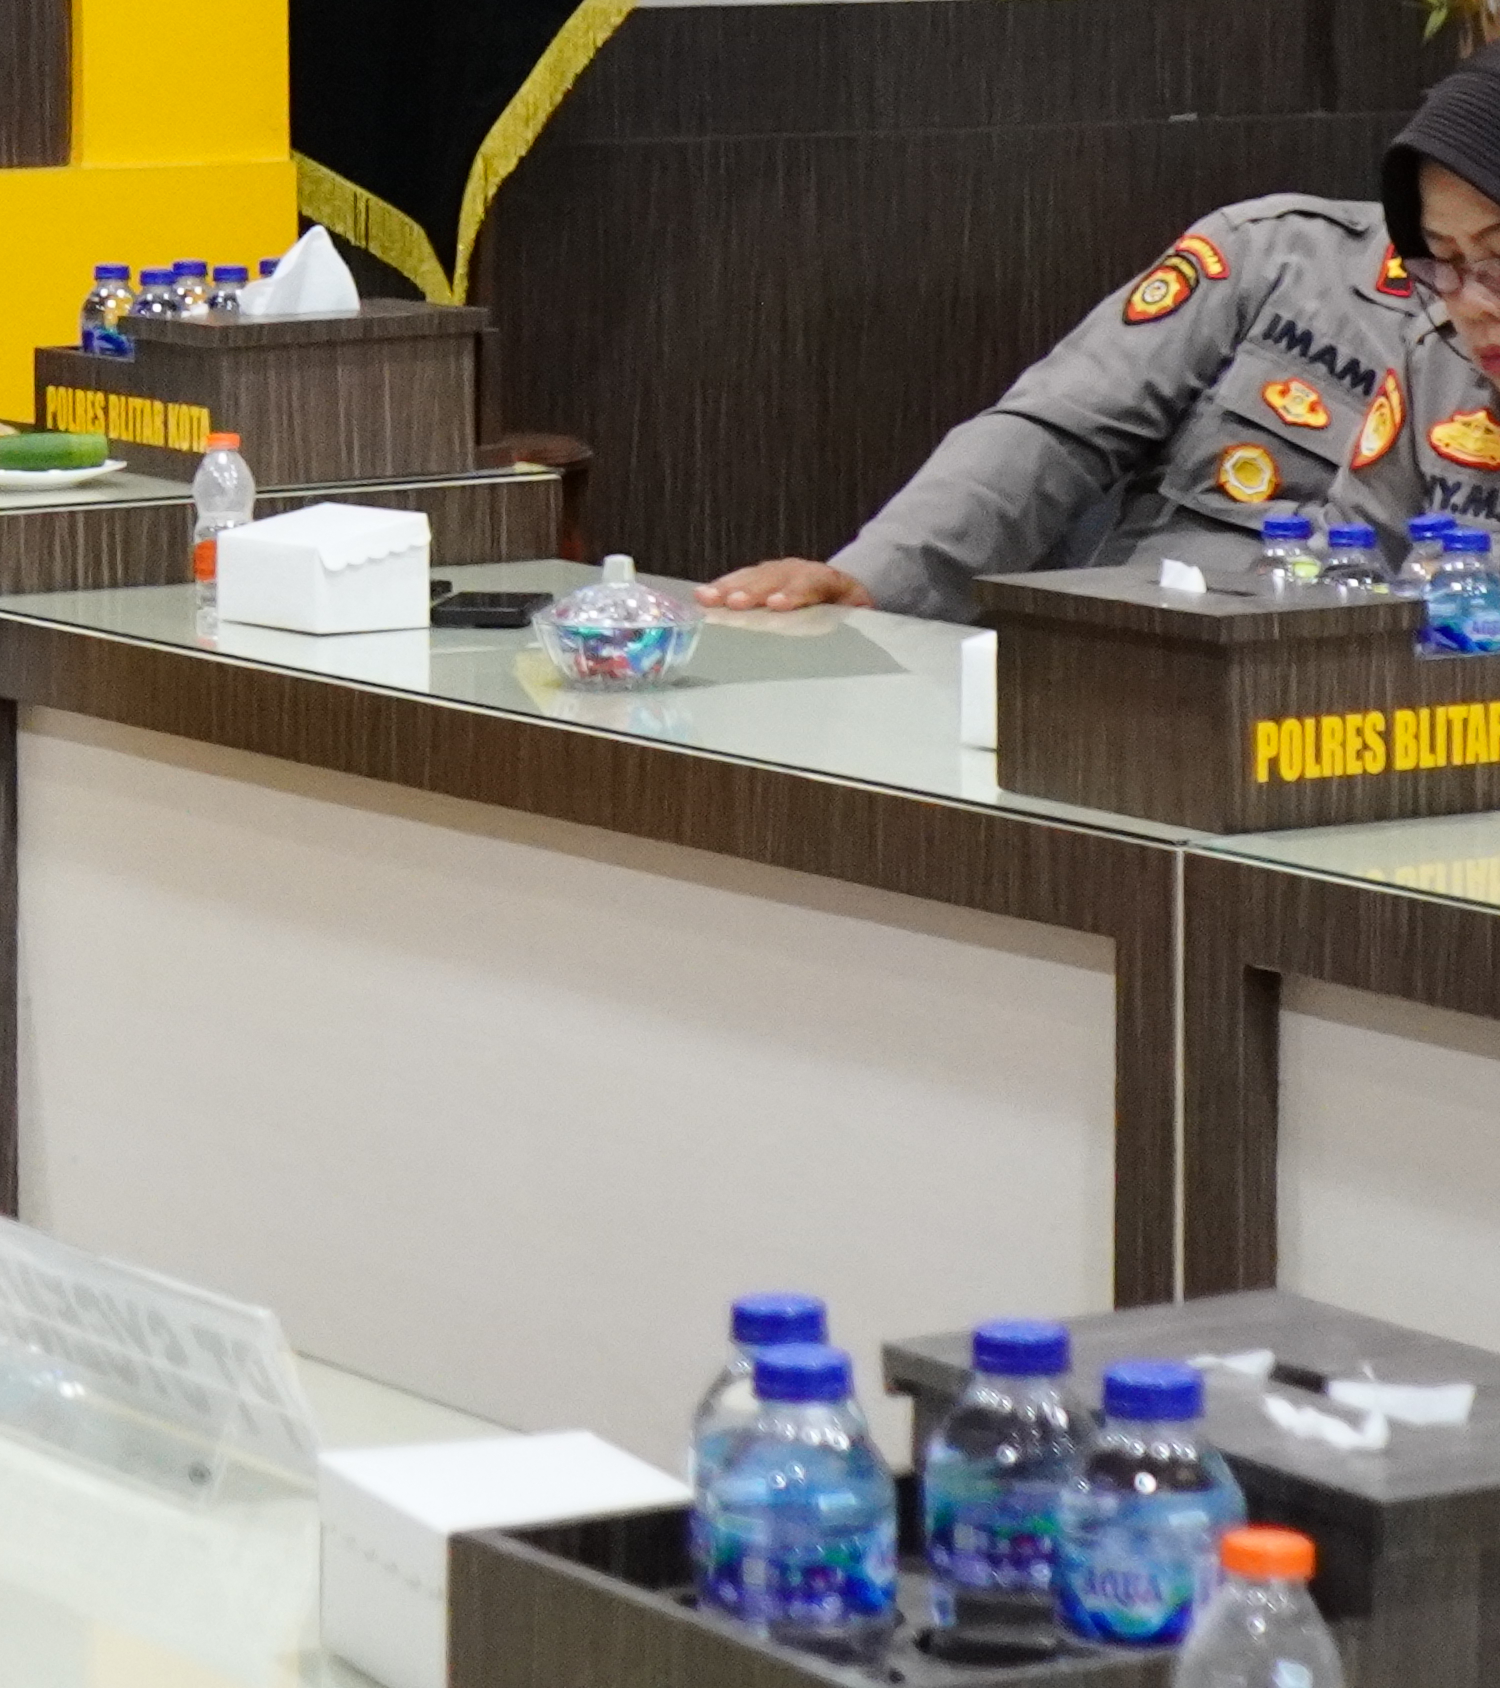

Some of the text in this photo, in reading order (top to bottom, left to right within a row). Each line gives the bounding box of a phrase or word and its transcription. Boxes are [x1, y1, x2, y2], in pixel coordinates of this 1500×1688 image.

[1262, 313, 1377, 398] IMAM
[45, 384, 210, 455] POLRES BLITAR KOTA
[1254, 711, 1388, 784] POLRES
